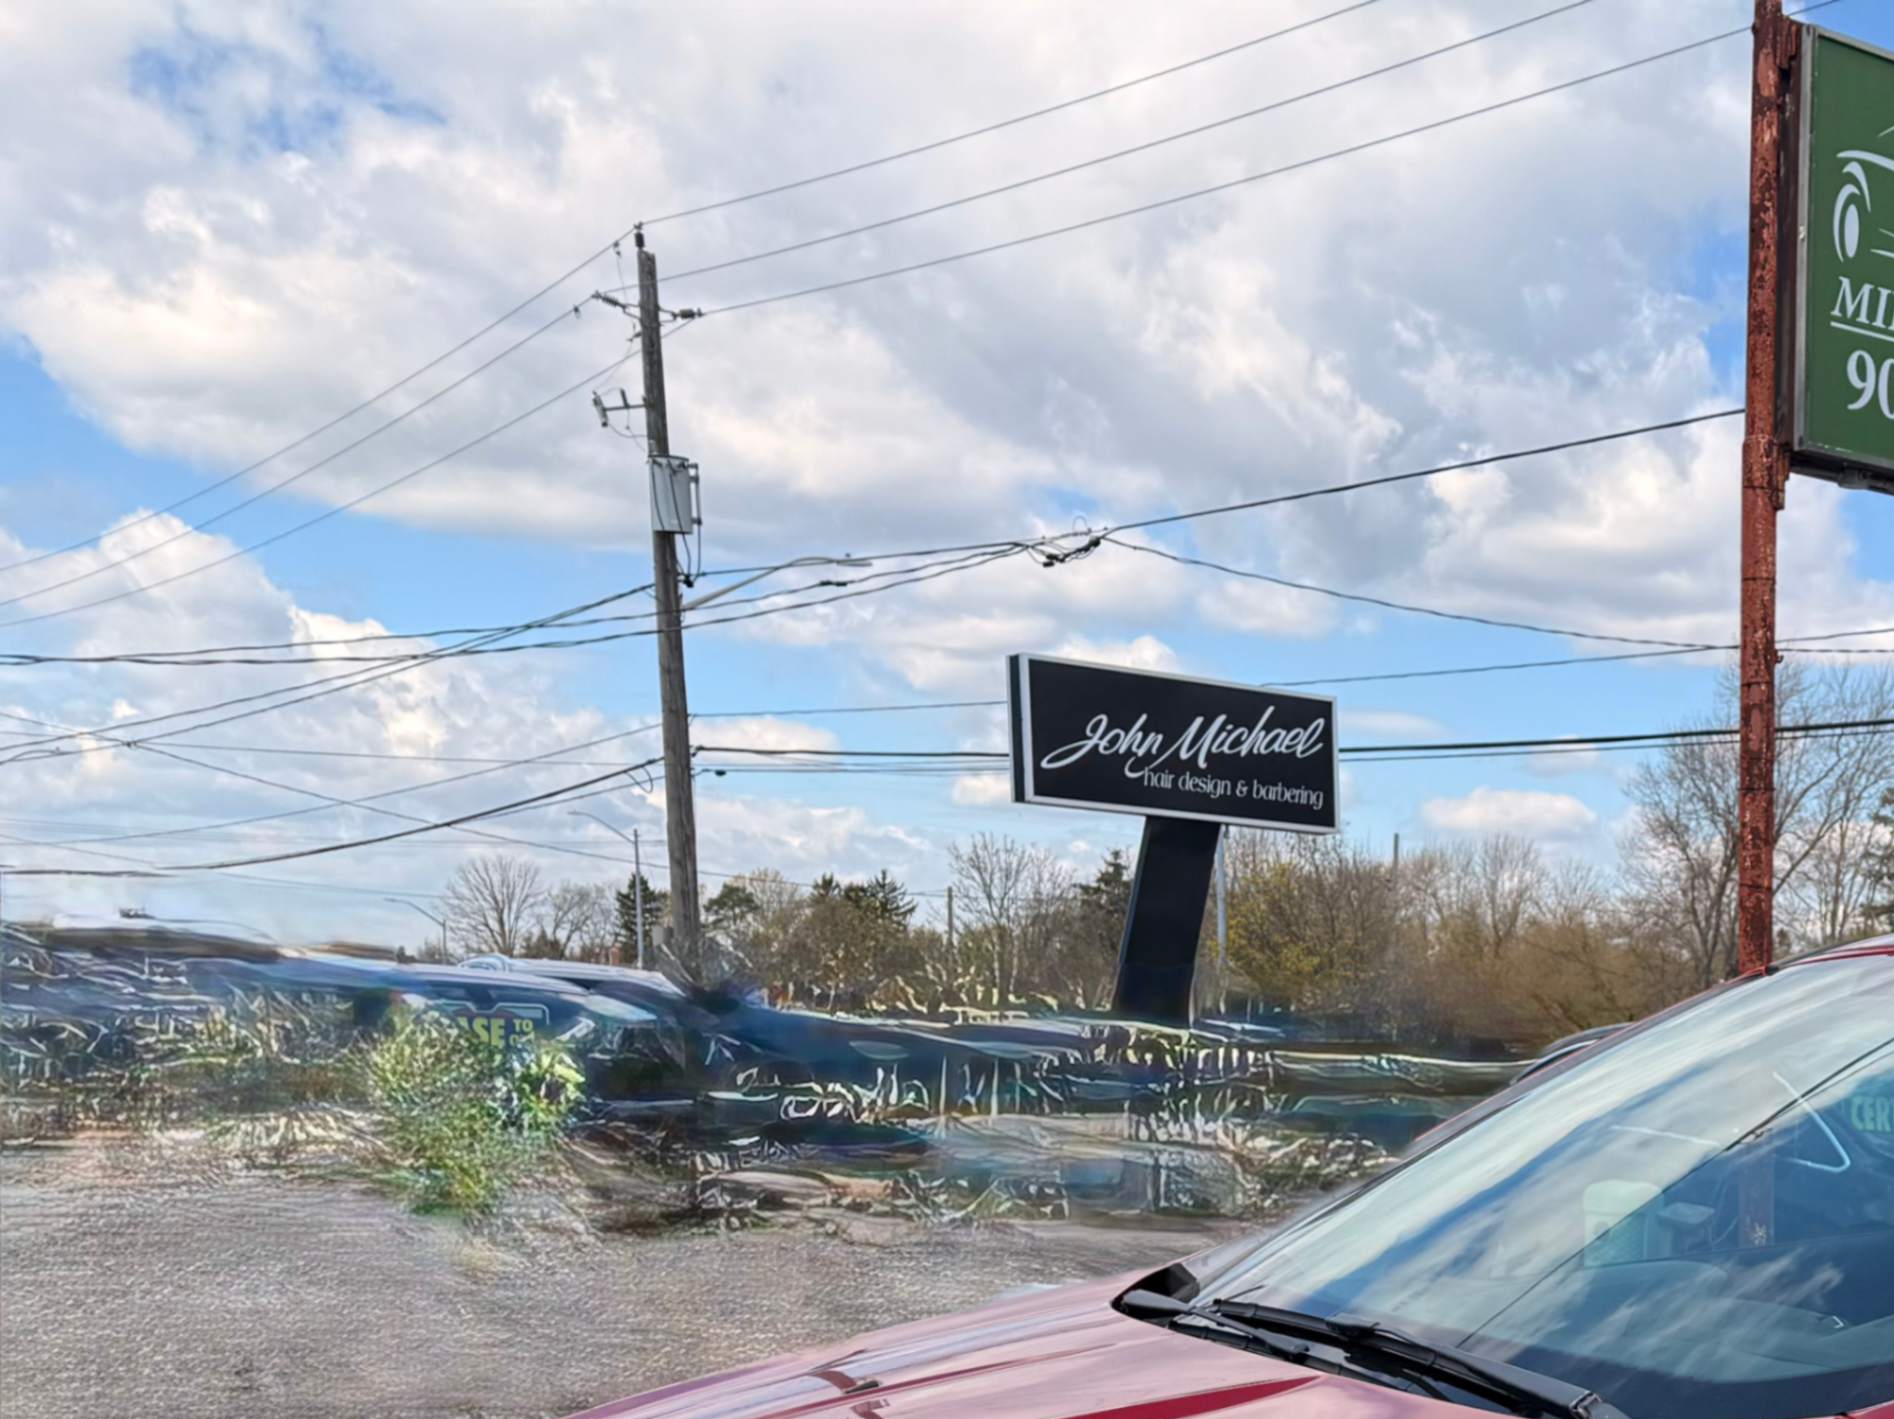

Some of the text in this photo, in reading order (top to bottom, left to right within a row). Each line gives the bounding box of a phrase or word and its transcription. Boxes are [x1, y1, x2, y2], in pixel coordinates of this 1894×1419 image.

[1040, 705, 1326, 778] John Michael
[1143, 767, 1324, 810] hair design & barbering
